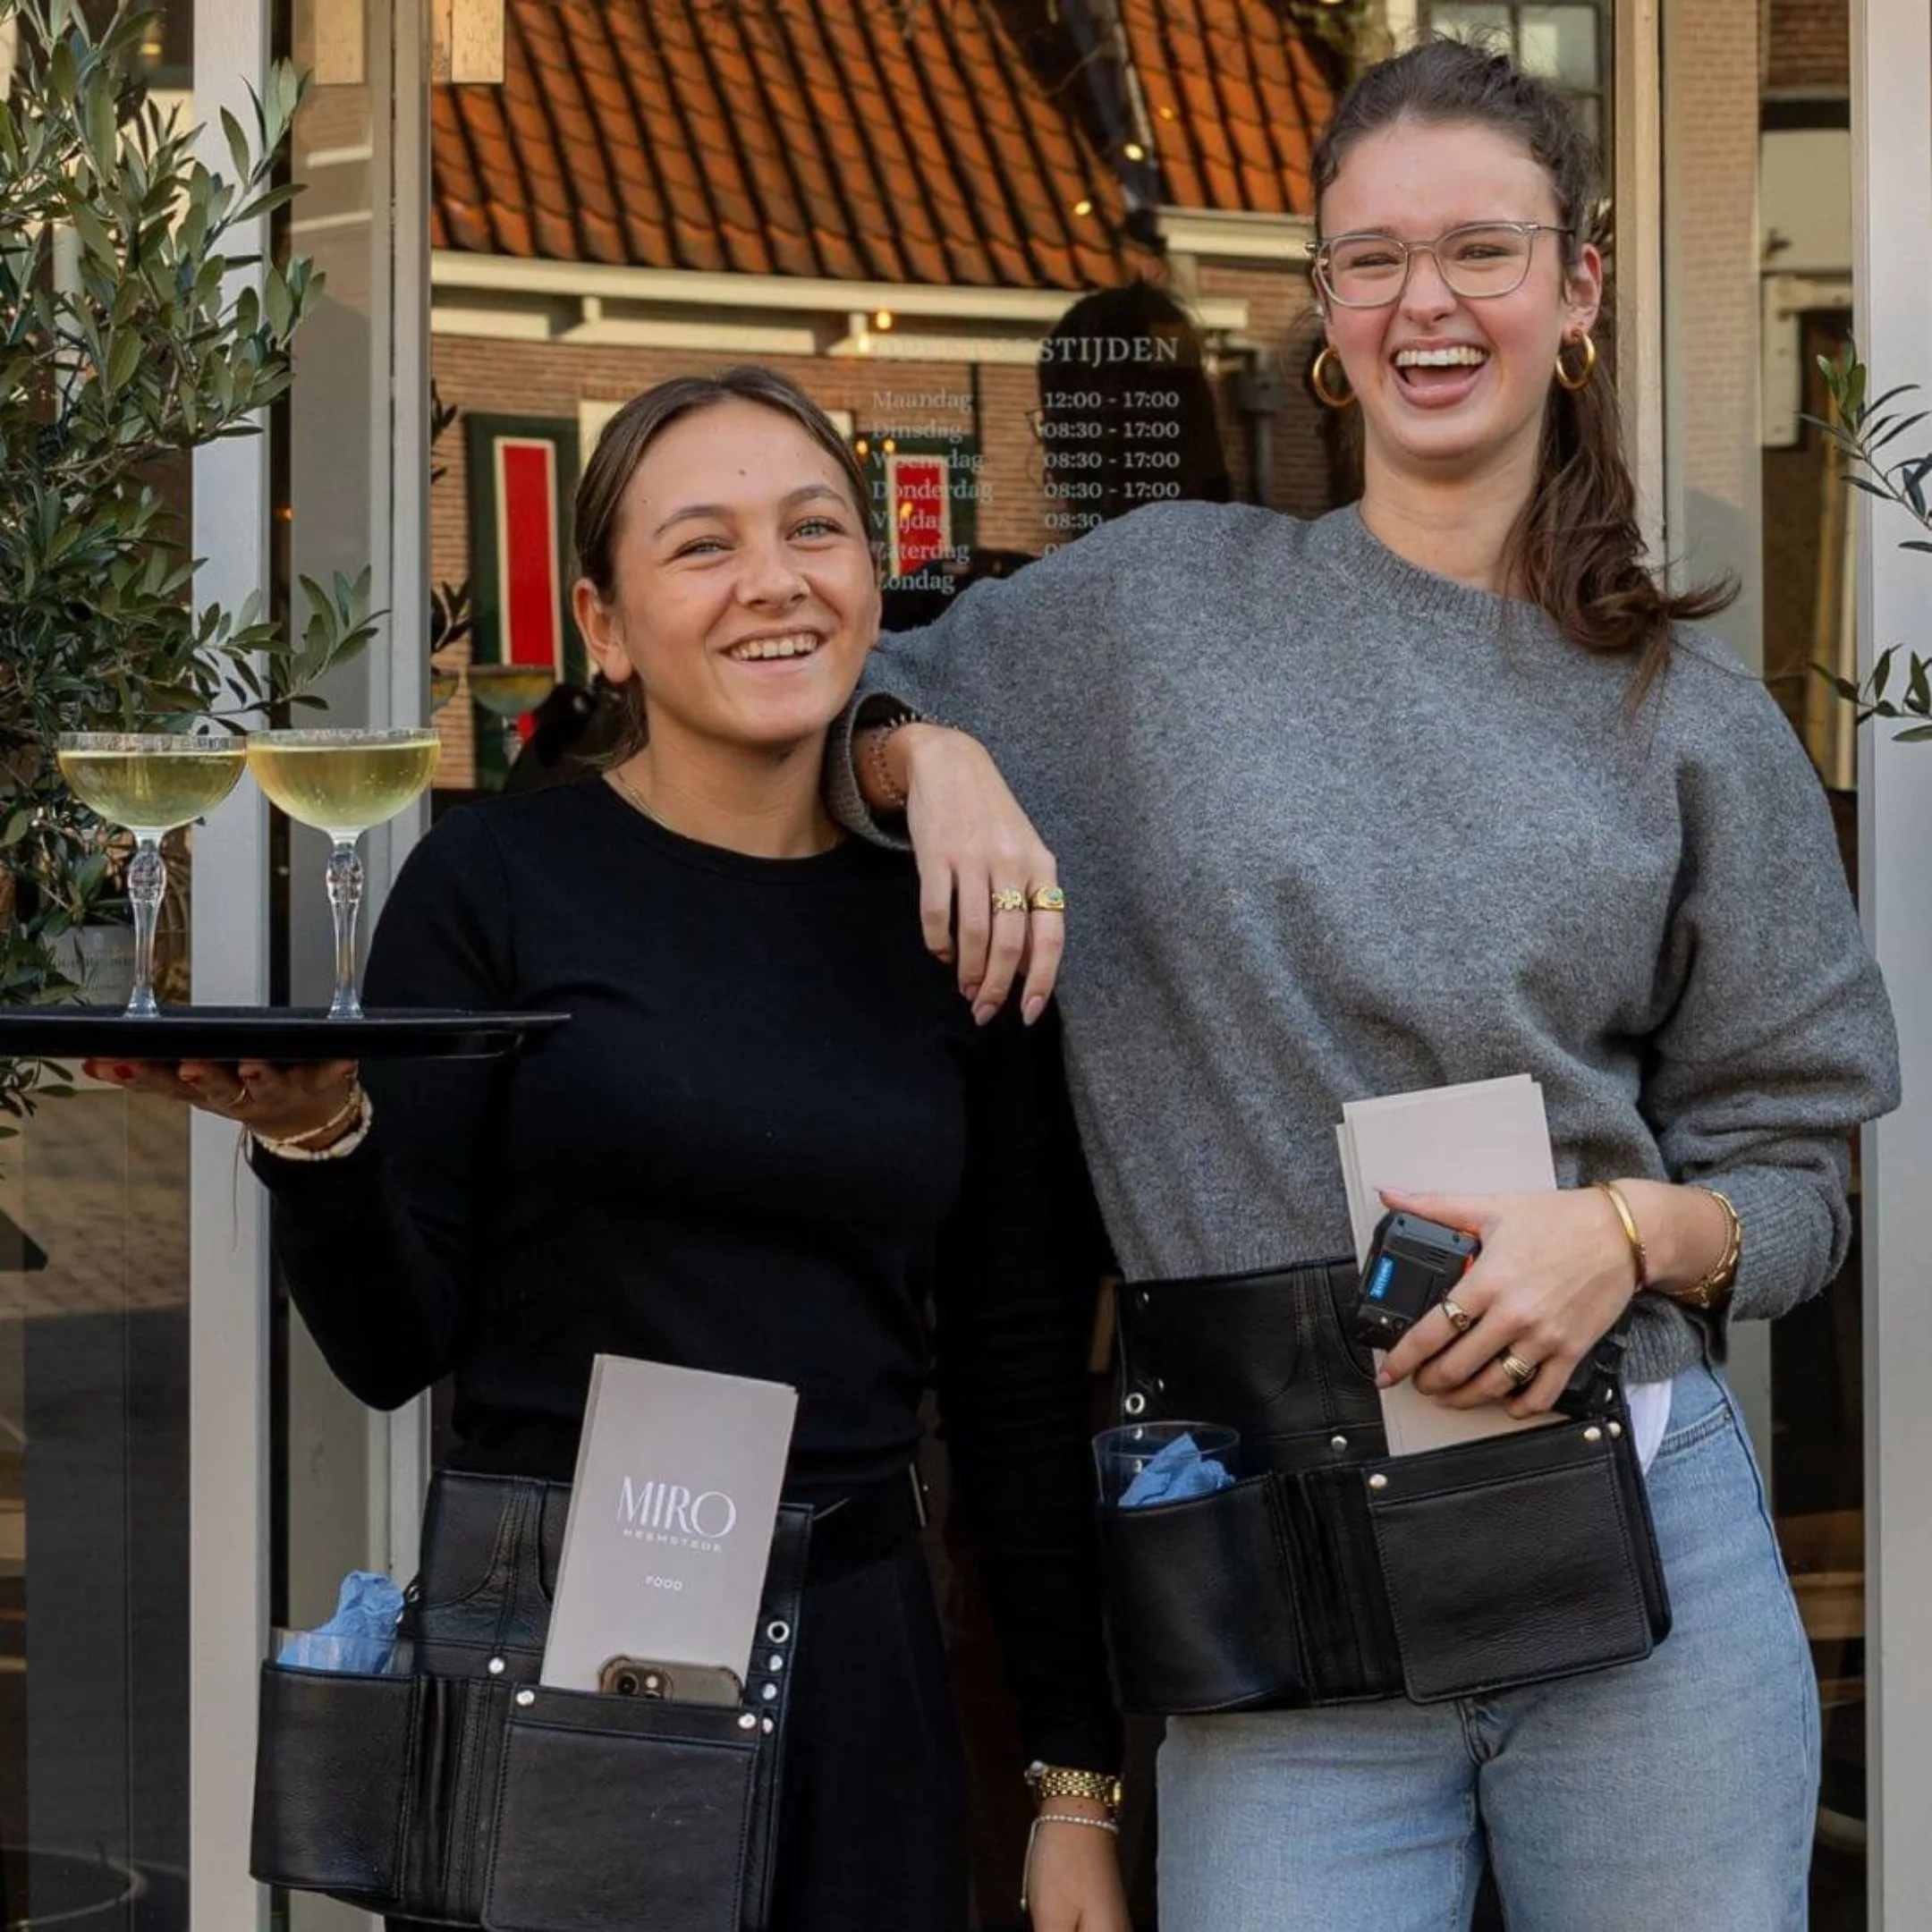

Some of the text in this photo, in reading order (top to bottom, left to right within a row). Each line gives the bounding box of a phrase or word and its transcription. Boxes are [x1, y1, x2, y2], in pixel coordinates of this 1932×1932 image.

[872, 388, 973, 415] Maandag
[1045, 391, 1102, 408] 12:00
[1123, 391, 1180, 408] 17:00
[872, 419, 963, 444] Dinsdag
[1044, 421, 1102, 438] 08:30
[1123, 421, 1180, 438] 17:00
[1045, 452, 1102, 468] 08:30
[1123, 452, 1180, 468] 17:00
[1044, 482, 1102, 498] 08:30
[1123, 482, 1180, 498] 17:00
[1045, 513, 1102, 530] 08:30
[617, 1475, 736, 1538] MIRO
[645, 1575, 683, 1591] FOOD
